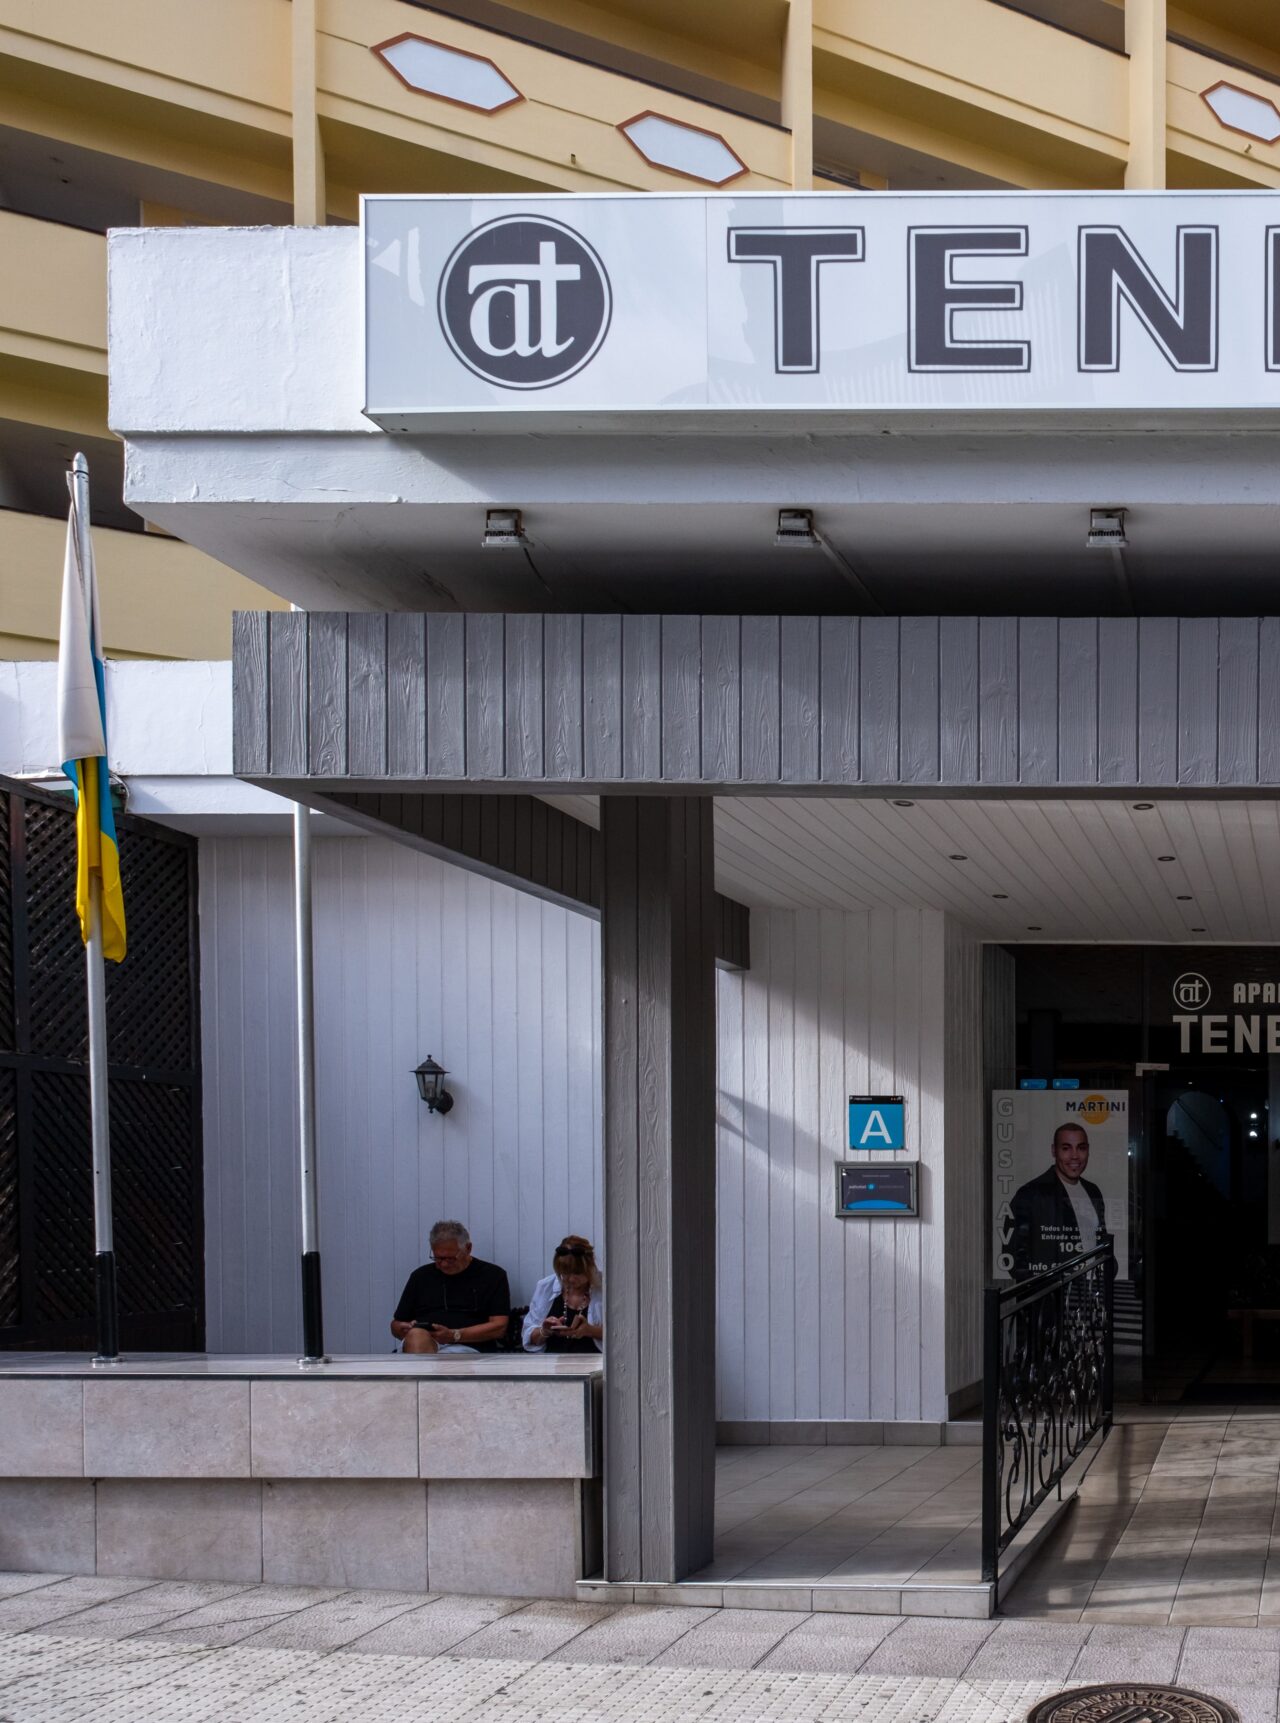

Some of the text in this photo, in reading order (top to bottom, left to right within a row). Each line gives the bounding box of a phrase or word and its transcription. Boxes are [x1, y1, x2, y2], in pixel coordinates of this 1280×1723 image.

[1066, 1101, 1126, 1112] MARTINI
[860, 1110, 893, 1144] A
[996, 1097, 1015, 1272] GUSTAVO
[1028, 1262, 1048, 1271] Info
